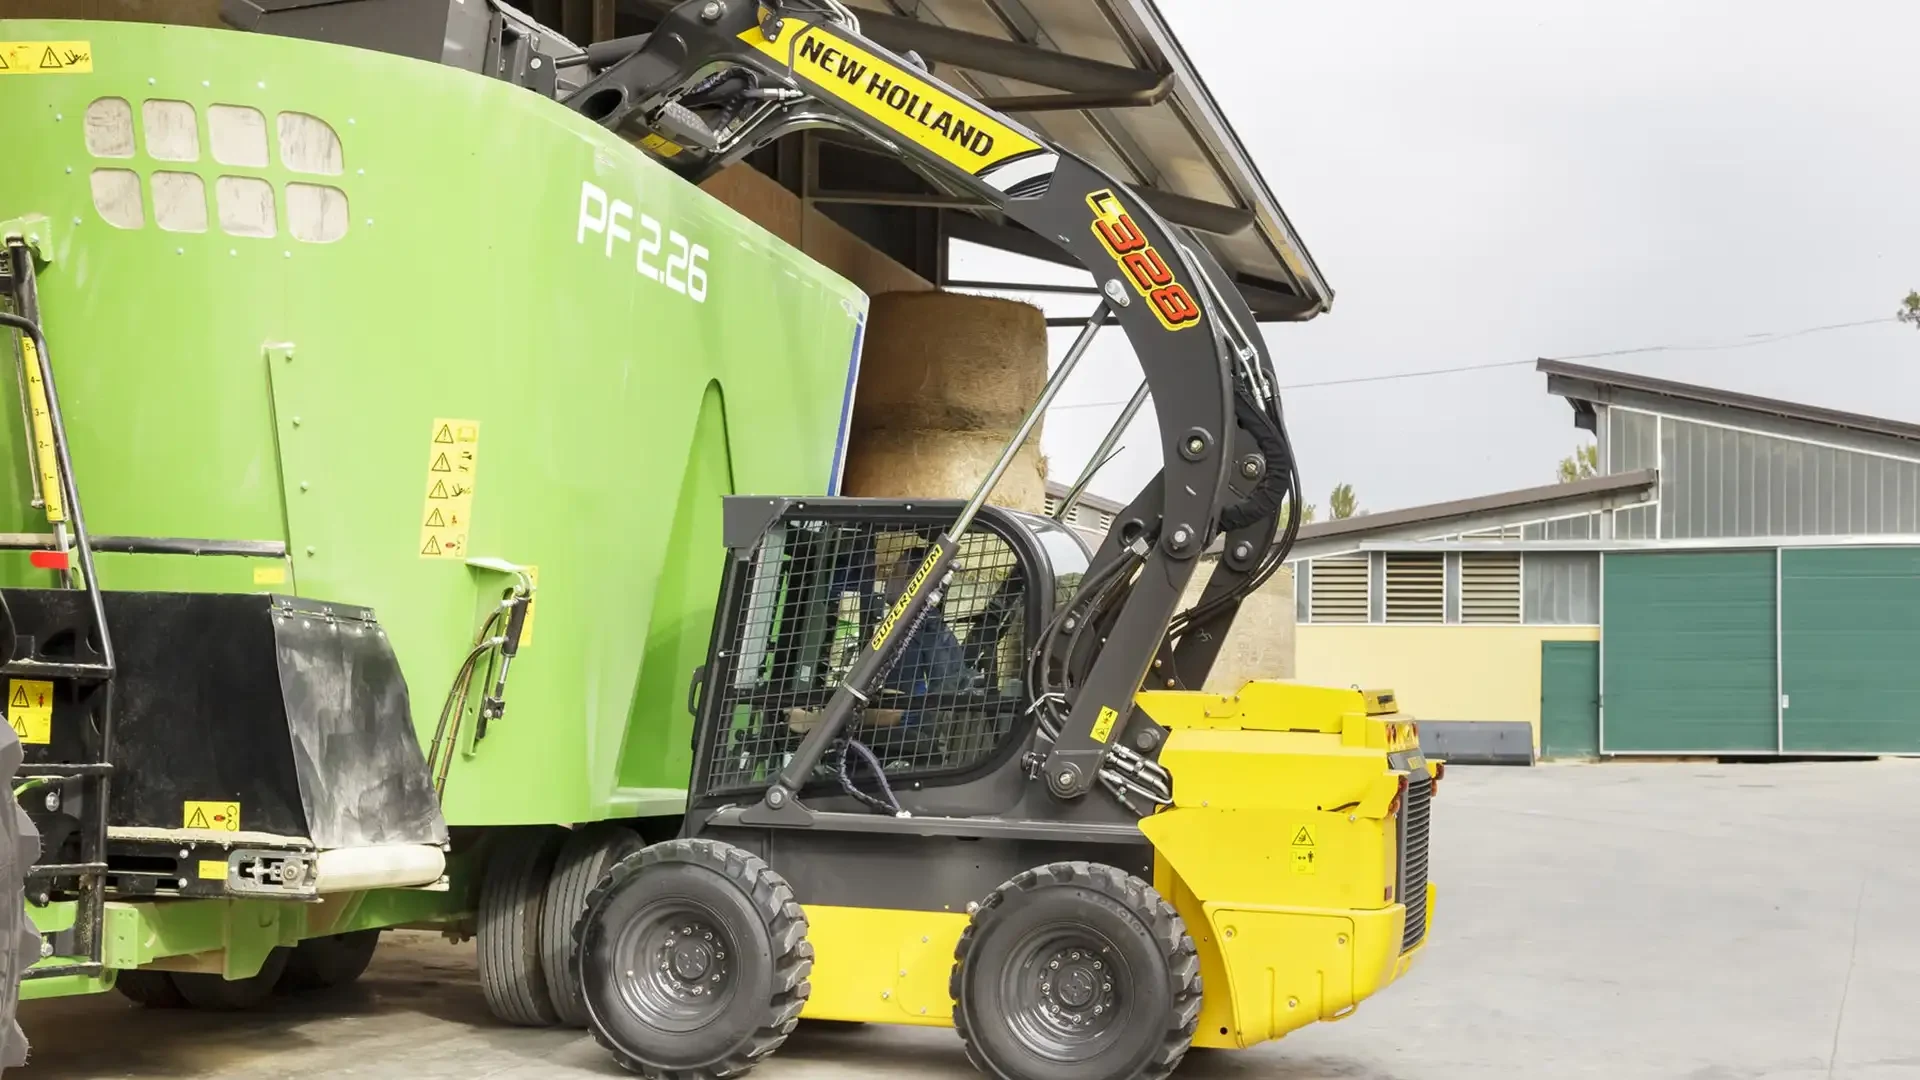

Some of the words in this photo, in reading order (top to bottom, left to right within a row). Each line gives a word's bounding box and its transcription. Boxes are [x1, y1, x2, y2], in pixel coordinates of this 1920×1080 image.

[799, 35, 868, 85] NEW
[865, 71, 995, 157] HOLLAND
[577, 180, 634, 260] PF
[636, 213, 710, 304] 2.26
[1089, 191, 1200, 327] L328
[872, 593, 911, 649] SUPER
[908, 545, 941, 594] BOOM
